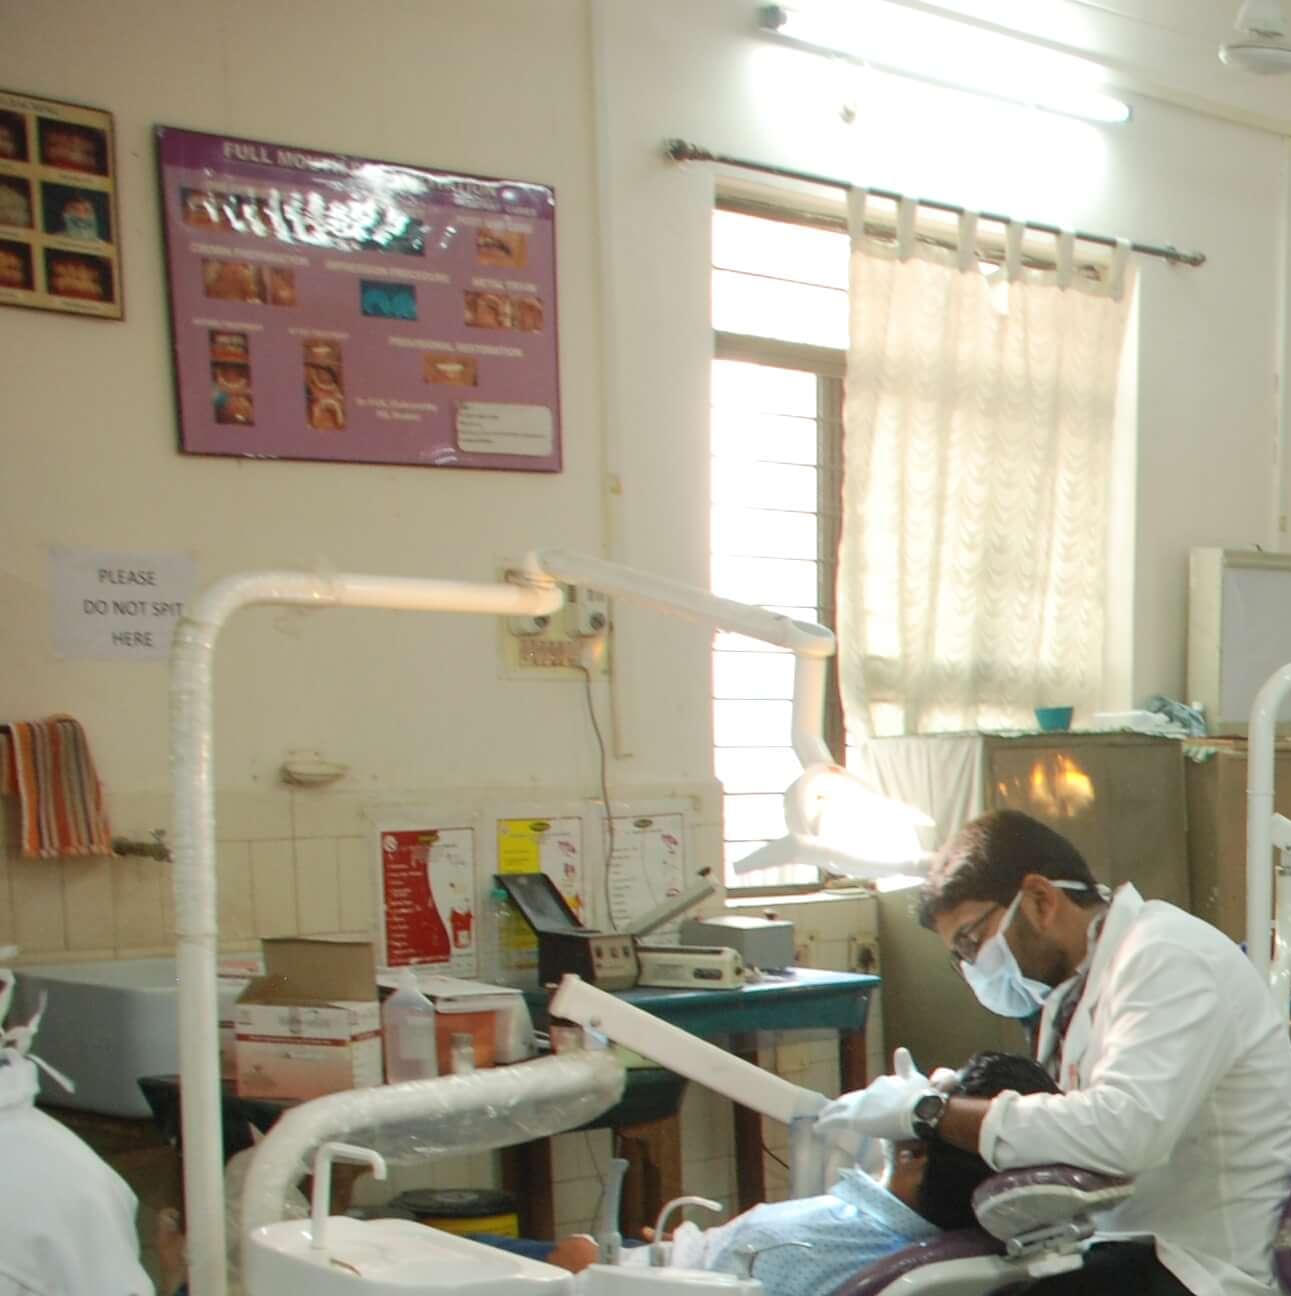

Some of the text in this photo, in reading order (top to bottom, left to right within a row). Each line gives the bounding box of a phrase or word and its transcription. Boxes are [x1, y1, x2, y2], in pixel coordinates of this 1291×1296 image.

[224, 141, 272, 164] FULL
[98, 568, 157, 586] PLEASE
[82, 598, 184, 617] DO NOT SPIT
[111, 631, 153, 647] HERE
